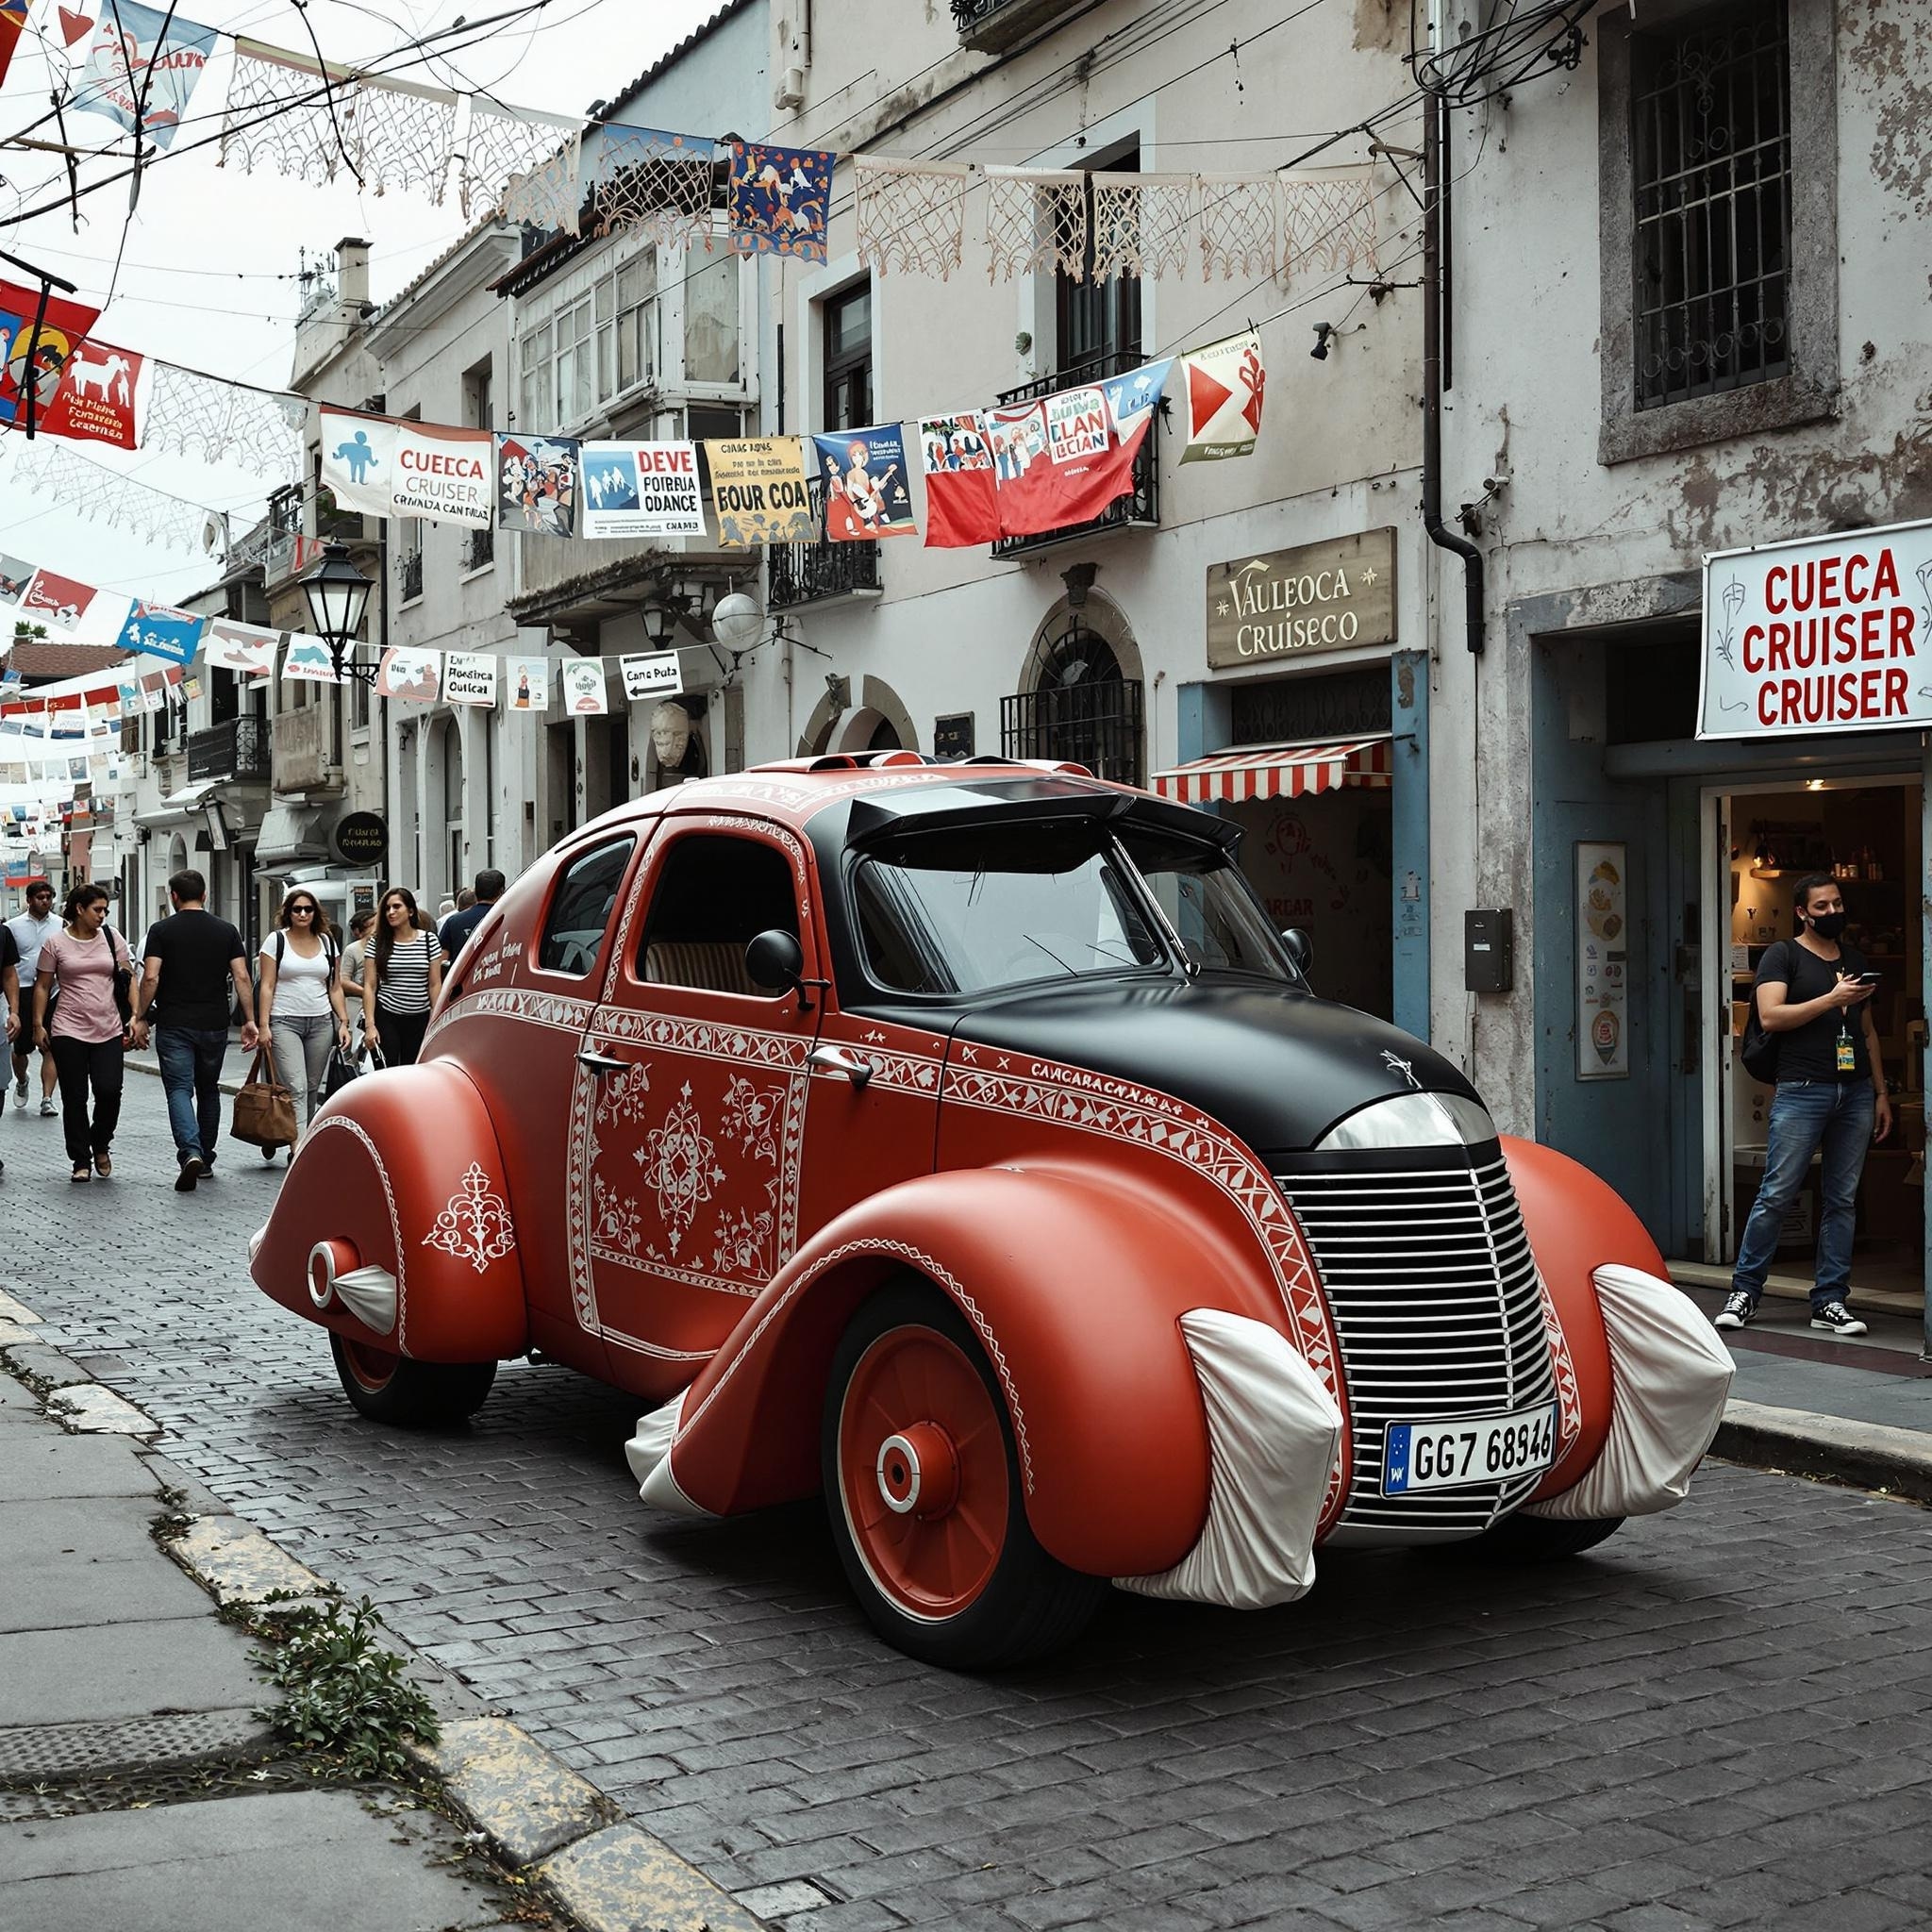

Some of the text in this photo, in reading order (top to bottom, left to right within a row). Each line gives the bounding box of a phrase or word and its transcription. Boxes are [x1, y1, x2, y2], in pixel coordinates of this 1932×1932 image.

[638, 451, 693, 473] DEVE
[406, 476, 478, 505] CRUISER
[1765, 548, 1901, 615] CUECA
[1743, 607, 1916, 674] CRUISER
[1758, 668, 1909, 725] CRUISER
[1415, 1432, 1477, 1480] GG7
